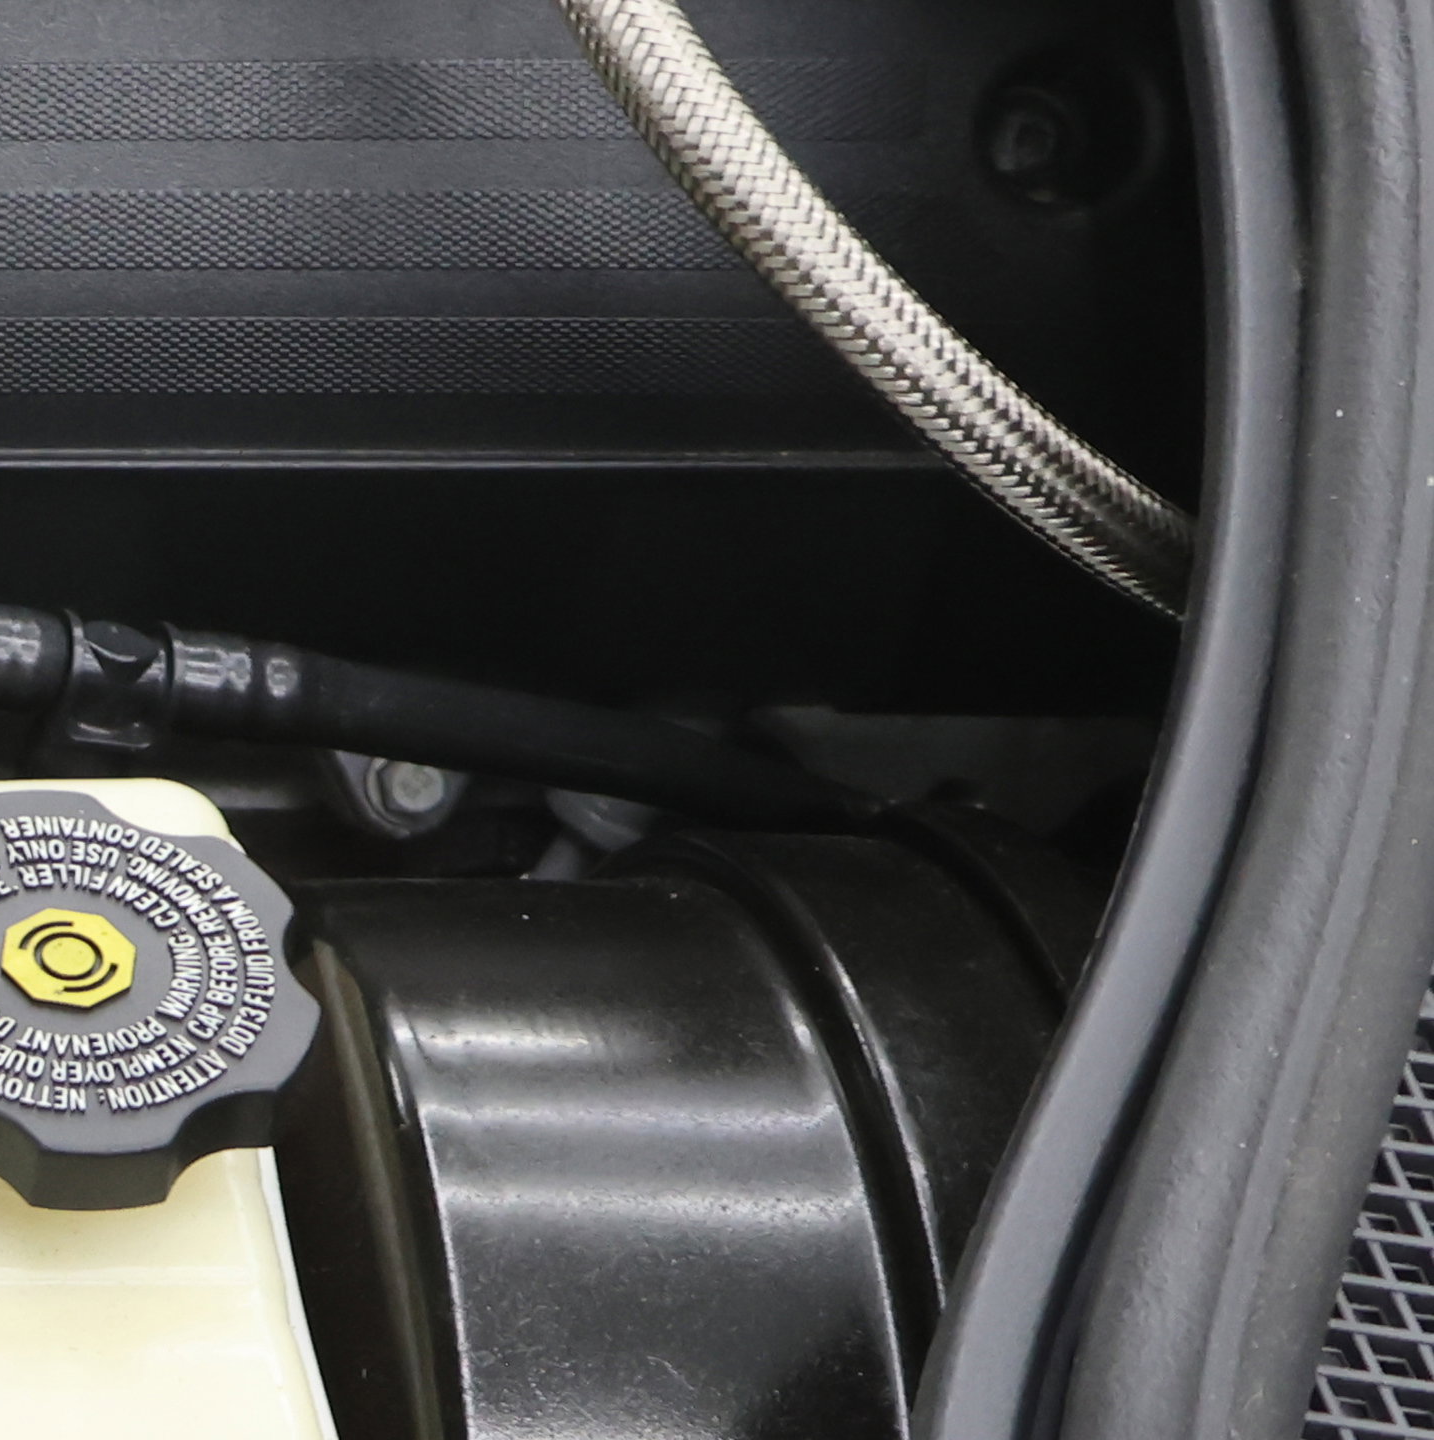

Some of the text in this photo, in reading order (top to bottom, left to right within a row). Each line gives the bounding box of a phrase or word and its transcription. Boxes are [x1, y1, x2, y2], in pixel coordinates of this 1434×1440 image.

[7, 839, 65, 863] ONLY
[71, 841, 120, 868] USE
[139, 836, 223, 890] SEALED
[211, 885, 239, 901] A
[18, 863, 202, 1018] WARNING: CLEAN FILLER
[221, 900, 270, 952] FROM
[204, 933, 238, 1006] BEFORE
[243, 954, 275, 1008] FLUID
[16, 1015, 167, 1057] PROVENANT
[187, 1002, 227, 1039] CAP
[51, 1034, 197, 1084] N'EMPLOYER
[98, 1049, 228, 1110] ATTENTION:
